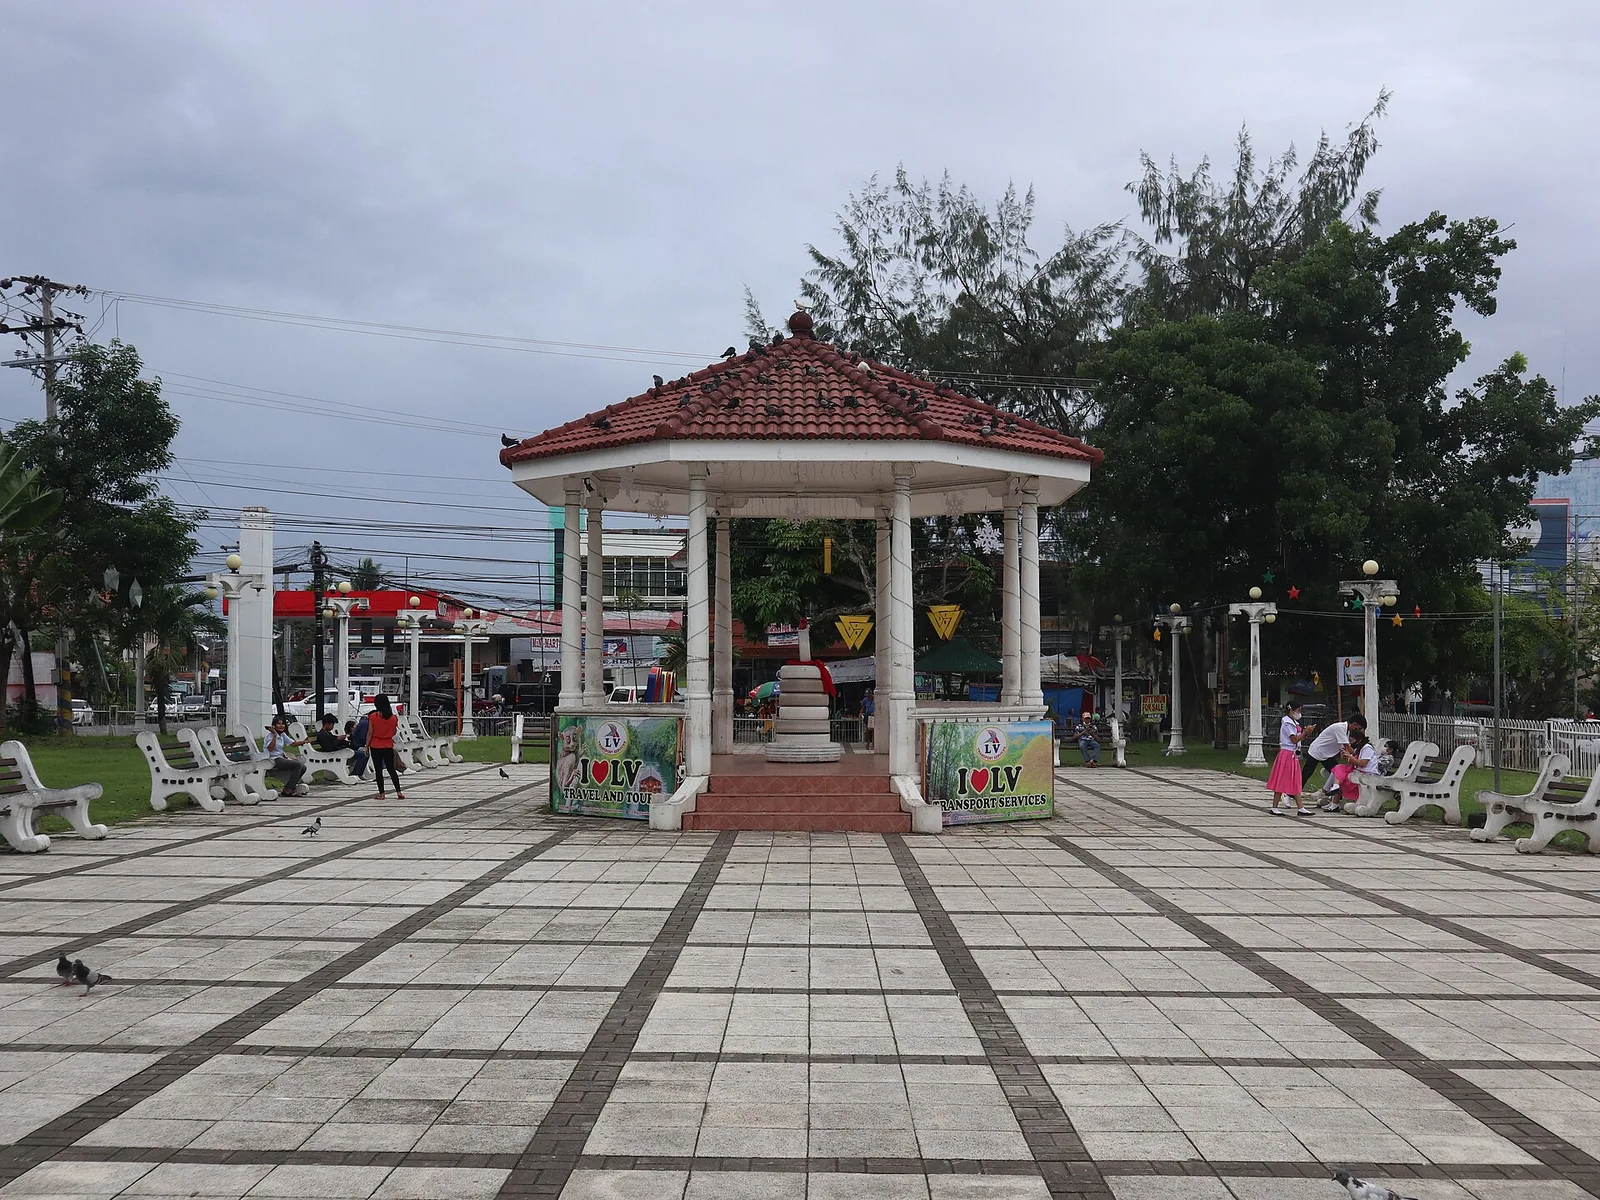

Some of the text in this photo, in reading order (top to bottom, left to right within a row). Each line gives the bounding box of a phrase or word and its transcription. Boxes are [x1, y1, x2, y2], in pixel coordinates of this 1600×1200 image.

[605, 738, 621, 748] LV
[985, 744, 1000, 754] LV
[580, 758, 642, 787] I LV
[957, 766, 1022, 794] I LV
[564, 788, 600, 801] TRAVEL
[602, 791, 624, 803] AND
[999, 795, 1046, 807] SERVICES
